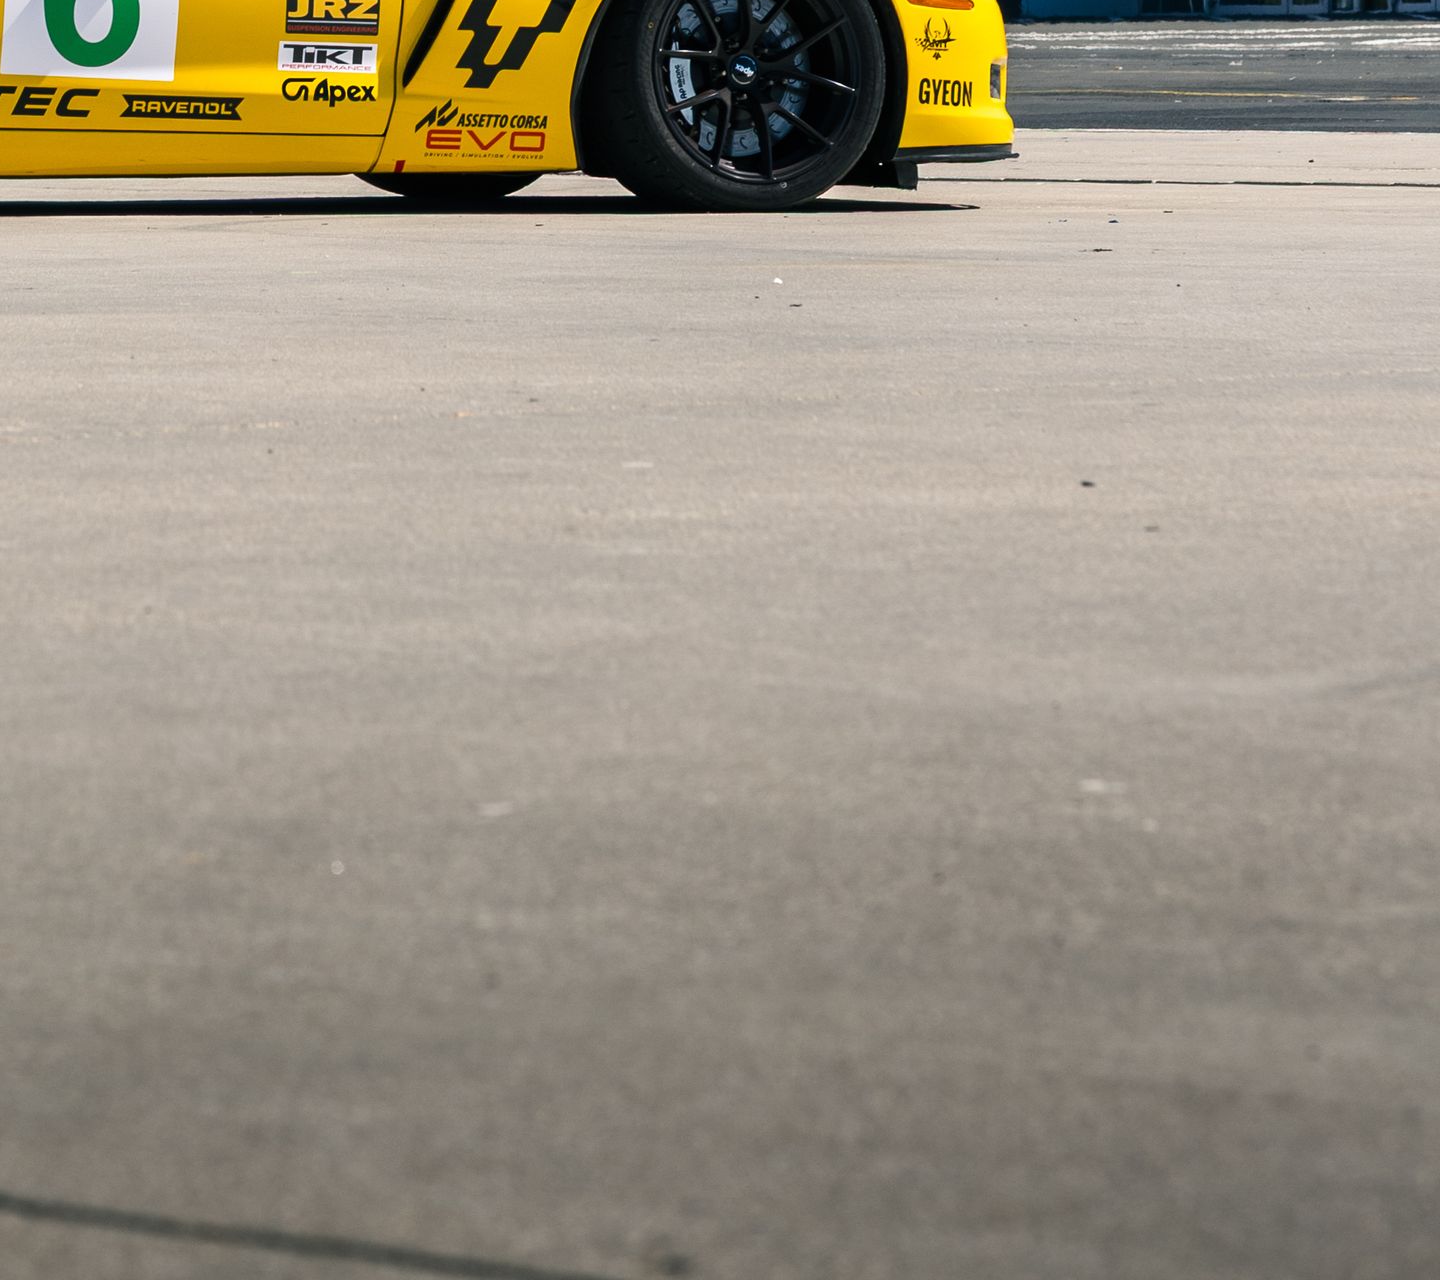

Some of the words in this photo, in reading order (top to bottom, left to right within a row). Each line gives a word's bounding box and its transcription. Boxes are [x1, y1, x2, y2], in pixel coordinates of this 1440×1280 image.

[287, 24, 330, 32] SUSPENSION
[331, 25, 378, 33] ENGINEERING
[281, 63, 372, 72] PERFORMANCE
[313, 78, 377, 108] Apex
[918, 77, 973, 107] GYEON
[456, 112, 509, 128] ASSETTO
[509, 114, 549, 130] CORSA
[425, 129, 546, 152] EVO
